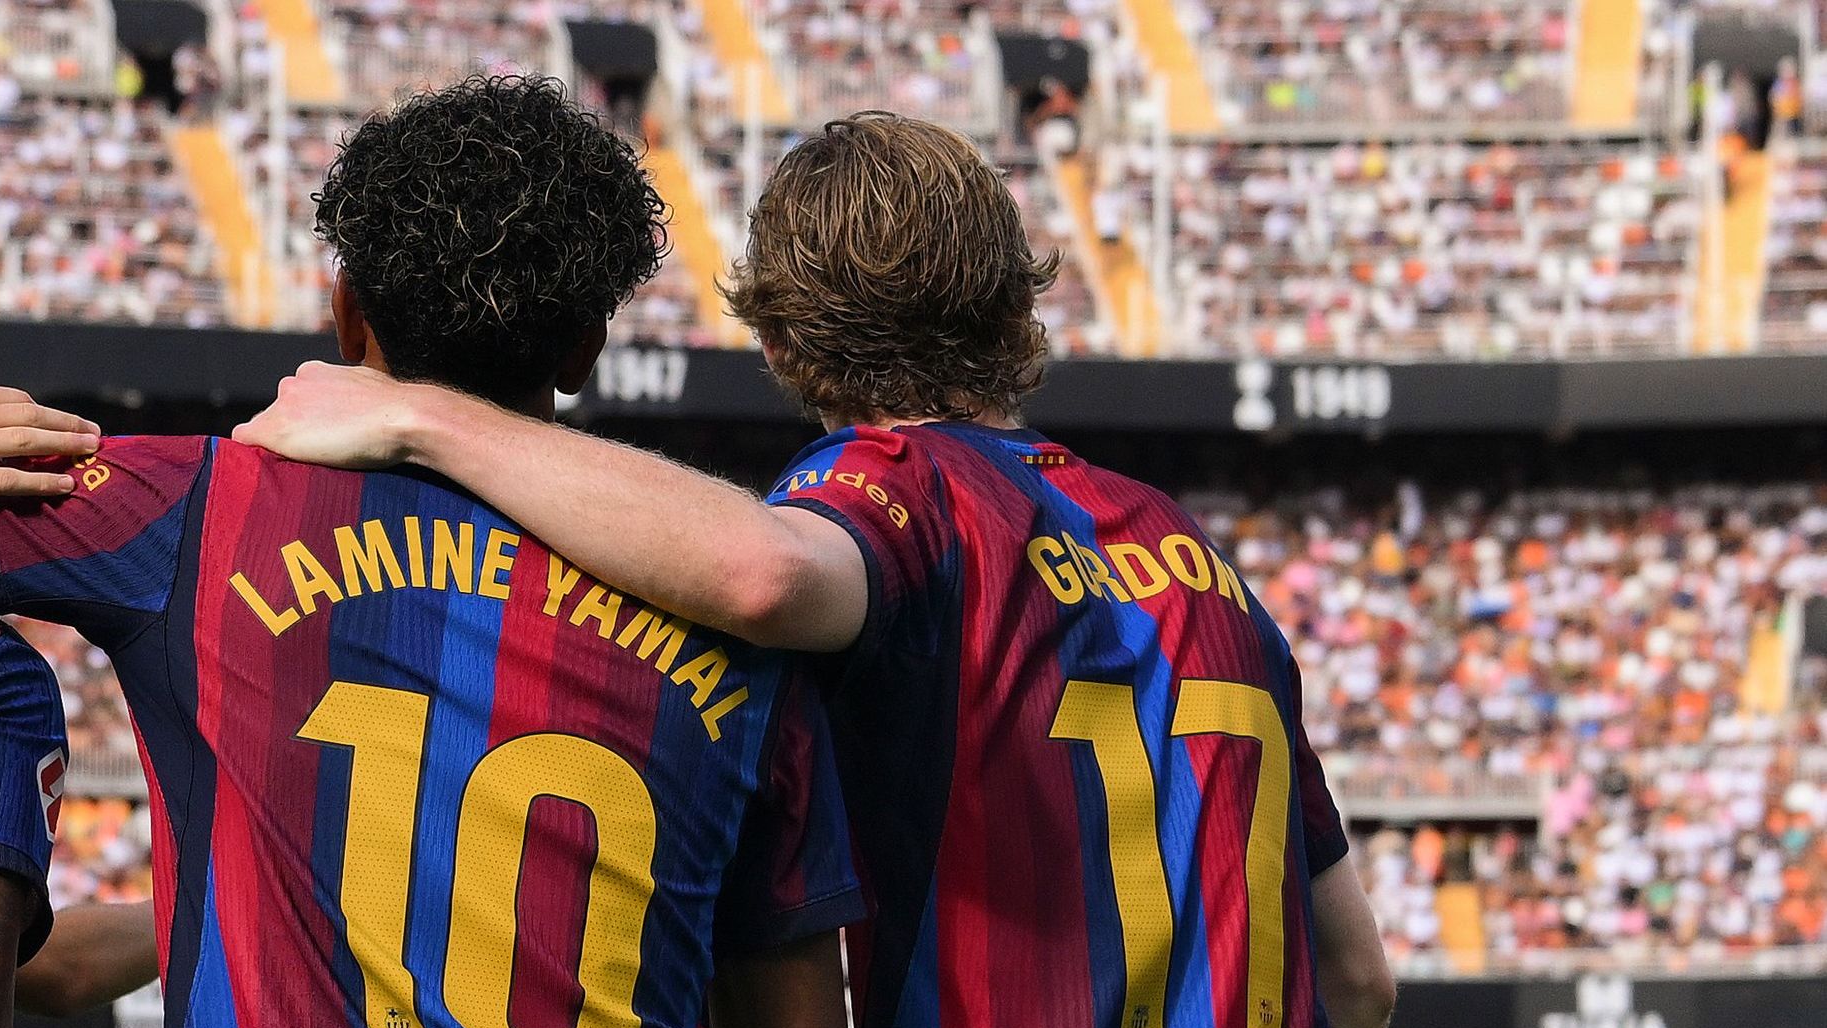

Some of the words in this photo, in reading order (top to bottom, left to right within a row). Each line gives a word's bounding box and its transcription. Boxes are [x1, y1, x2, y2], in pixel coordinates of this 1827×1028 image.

[229, 516, 520, 636] LAMINE
[542, 552, 749, 742] YAMAL
[1027, 530, 1249, 615] GORDON
